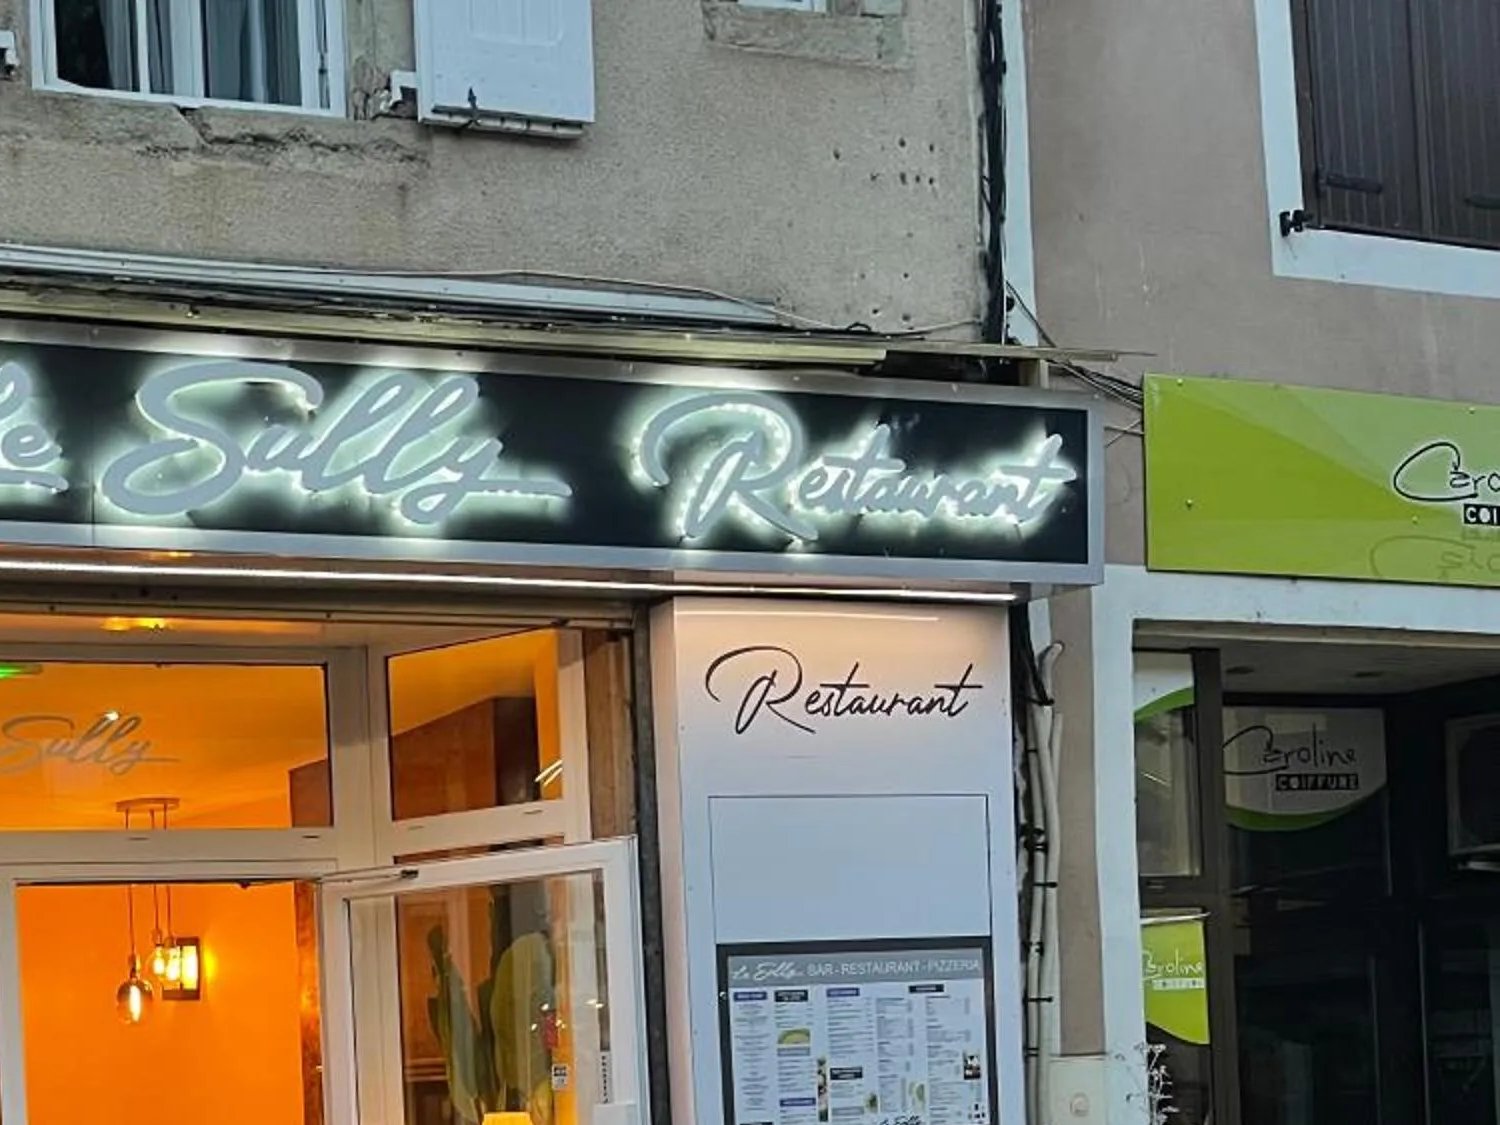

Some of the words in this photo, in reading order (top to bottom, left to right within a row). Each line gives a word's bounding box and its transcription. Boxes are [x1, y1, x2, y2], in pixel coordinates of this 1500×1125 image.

[102, 360, 571, 524] Sully
[639, 391, 1076, 541] Restaurant
[706, 646, 983, 734] Restaurant
[1222, 722, 1357, 774] Caroline
